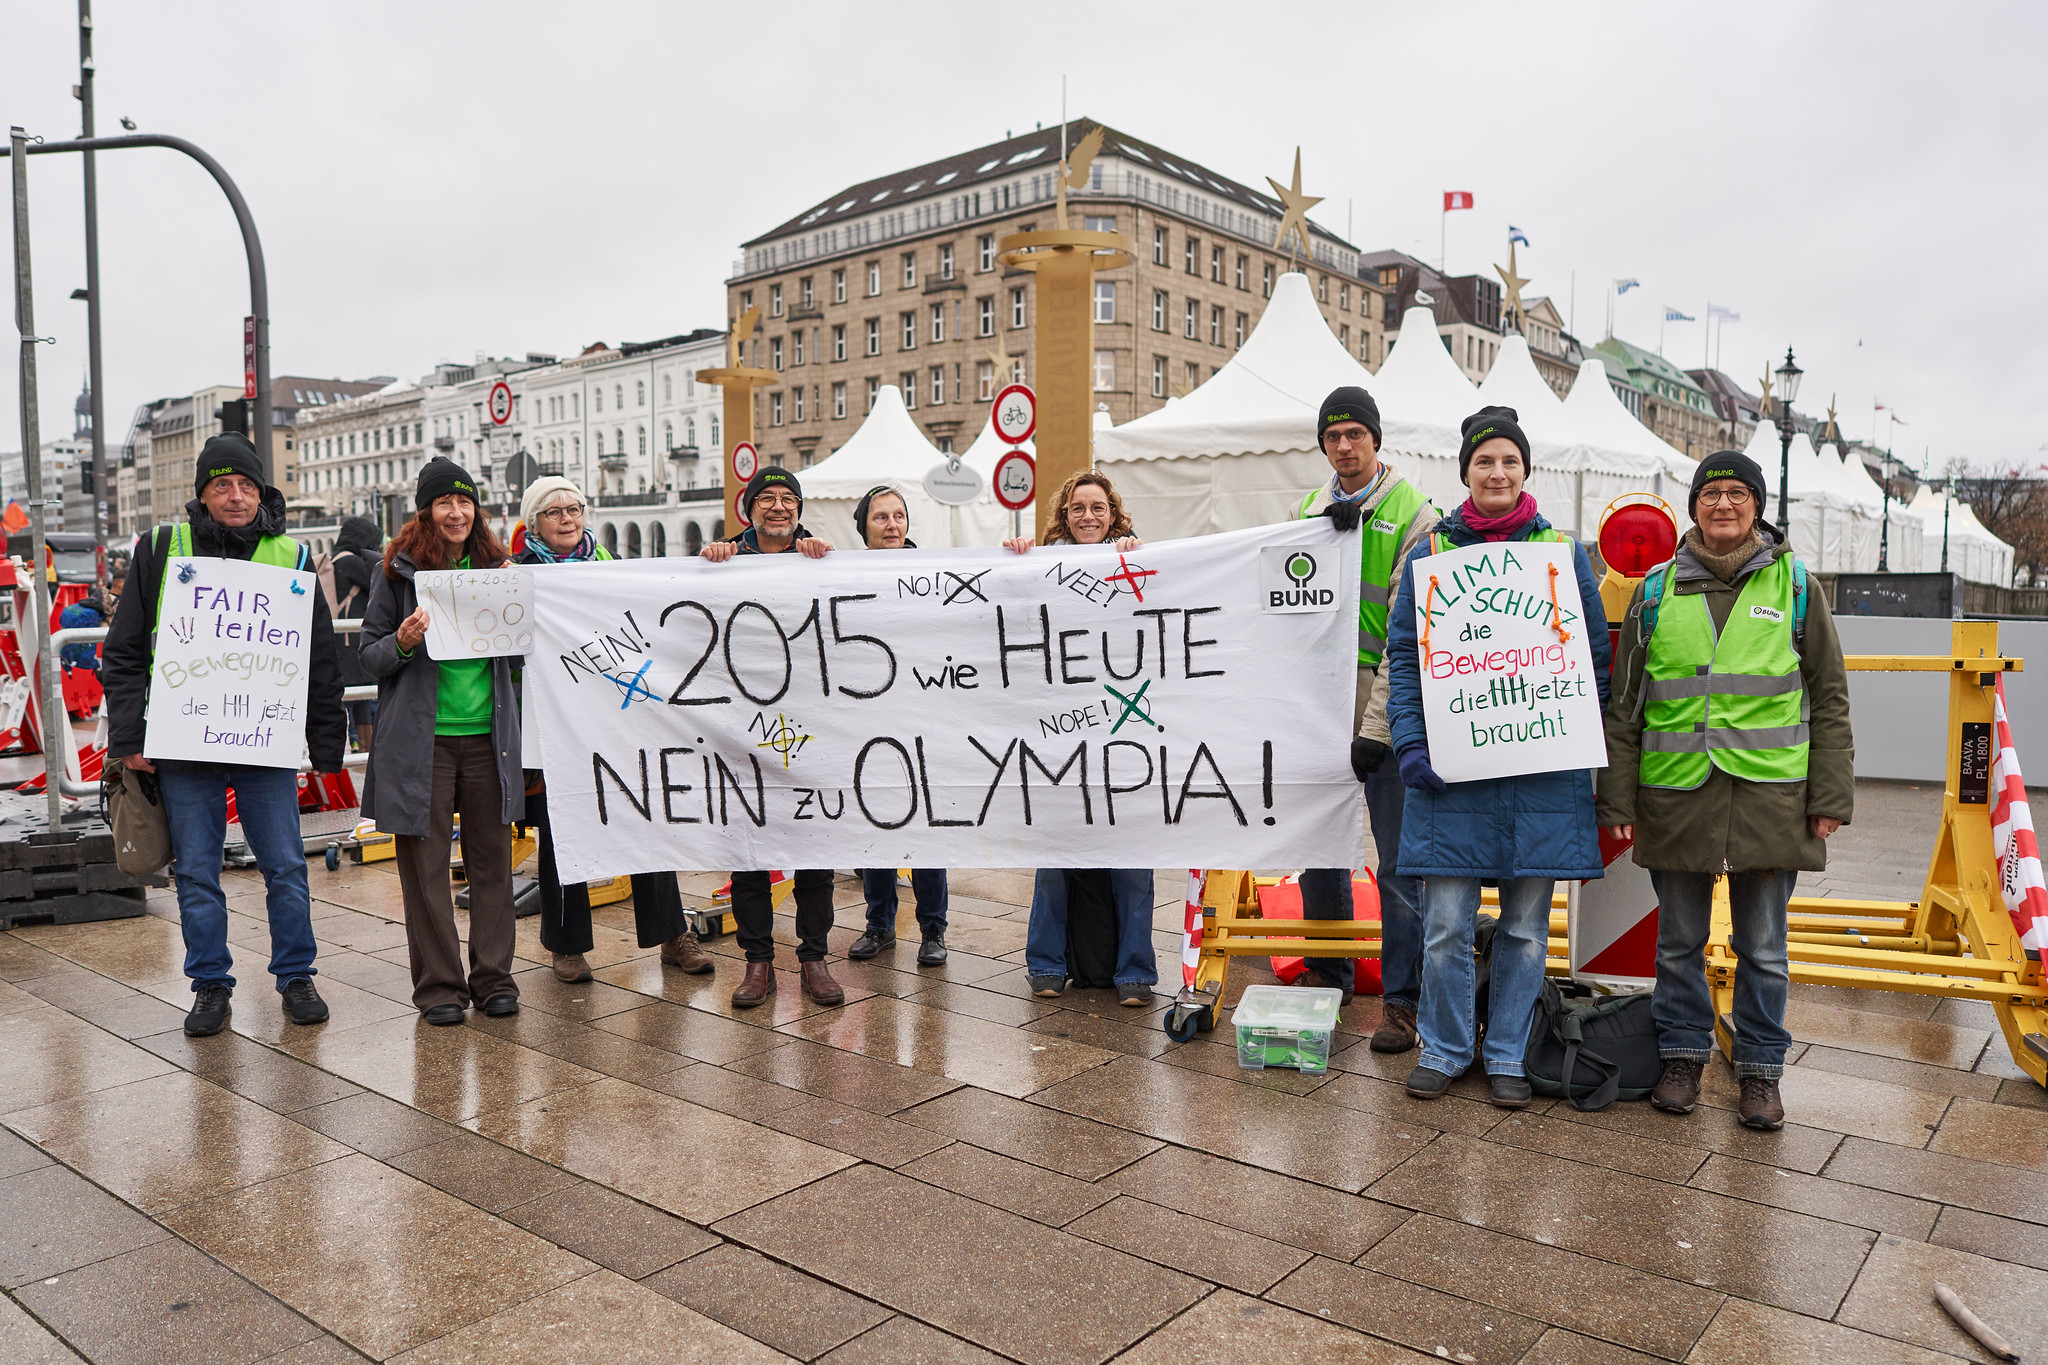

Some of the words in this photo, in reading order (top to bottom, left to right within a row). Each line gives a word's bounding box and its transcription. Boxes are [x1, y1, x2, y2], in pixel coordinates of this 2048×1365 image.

[215, 466, 232, 475] BUND
[421, 573, 465, 589] 2015
[481, 572, 520, 586] 2025
[897, 572, 941, 599] NO!
[1045, 562, 1118, 608] NEE!
[1417, 548, 1523, 628] KLIMA
[193, 586, 271, 616] FAIR
[1269, 590, 1334, 607] BUND
[1761, 609, 1780, 619] BUND
[215, 614, 300, 648] teilen
[1459, 623, 1492, 642] die
[659, 594, 897, 706] 2015
[912, 656, 979, 690] wie
[996, 603, 1226, 689] HEUTE
[1430, 643, 1576, 680] Bewegung,
[181, 697, 209, 716] die
[222, 693, 250, 718] HH
[257, 699, 297, 723] jetzt
[1449, 689, 1488, 713] die
[1528, 673, 1587, 711] jetzt
[1039, 700, 1112, 738] NOPE!
[1470, 709, 1567, 748] braucht
[203, 725, 273, 748] braucht
[1976, 735, 1989, 762] 1800
[1962, 739, 1973, 775] BAAVA
[1976, 765, 1987, 780] PL
[793, 788, 844, 821] zu
